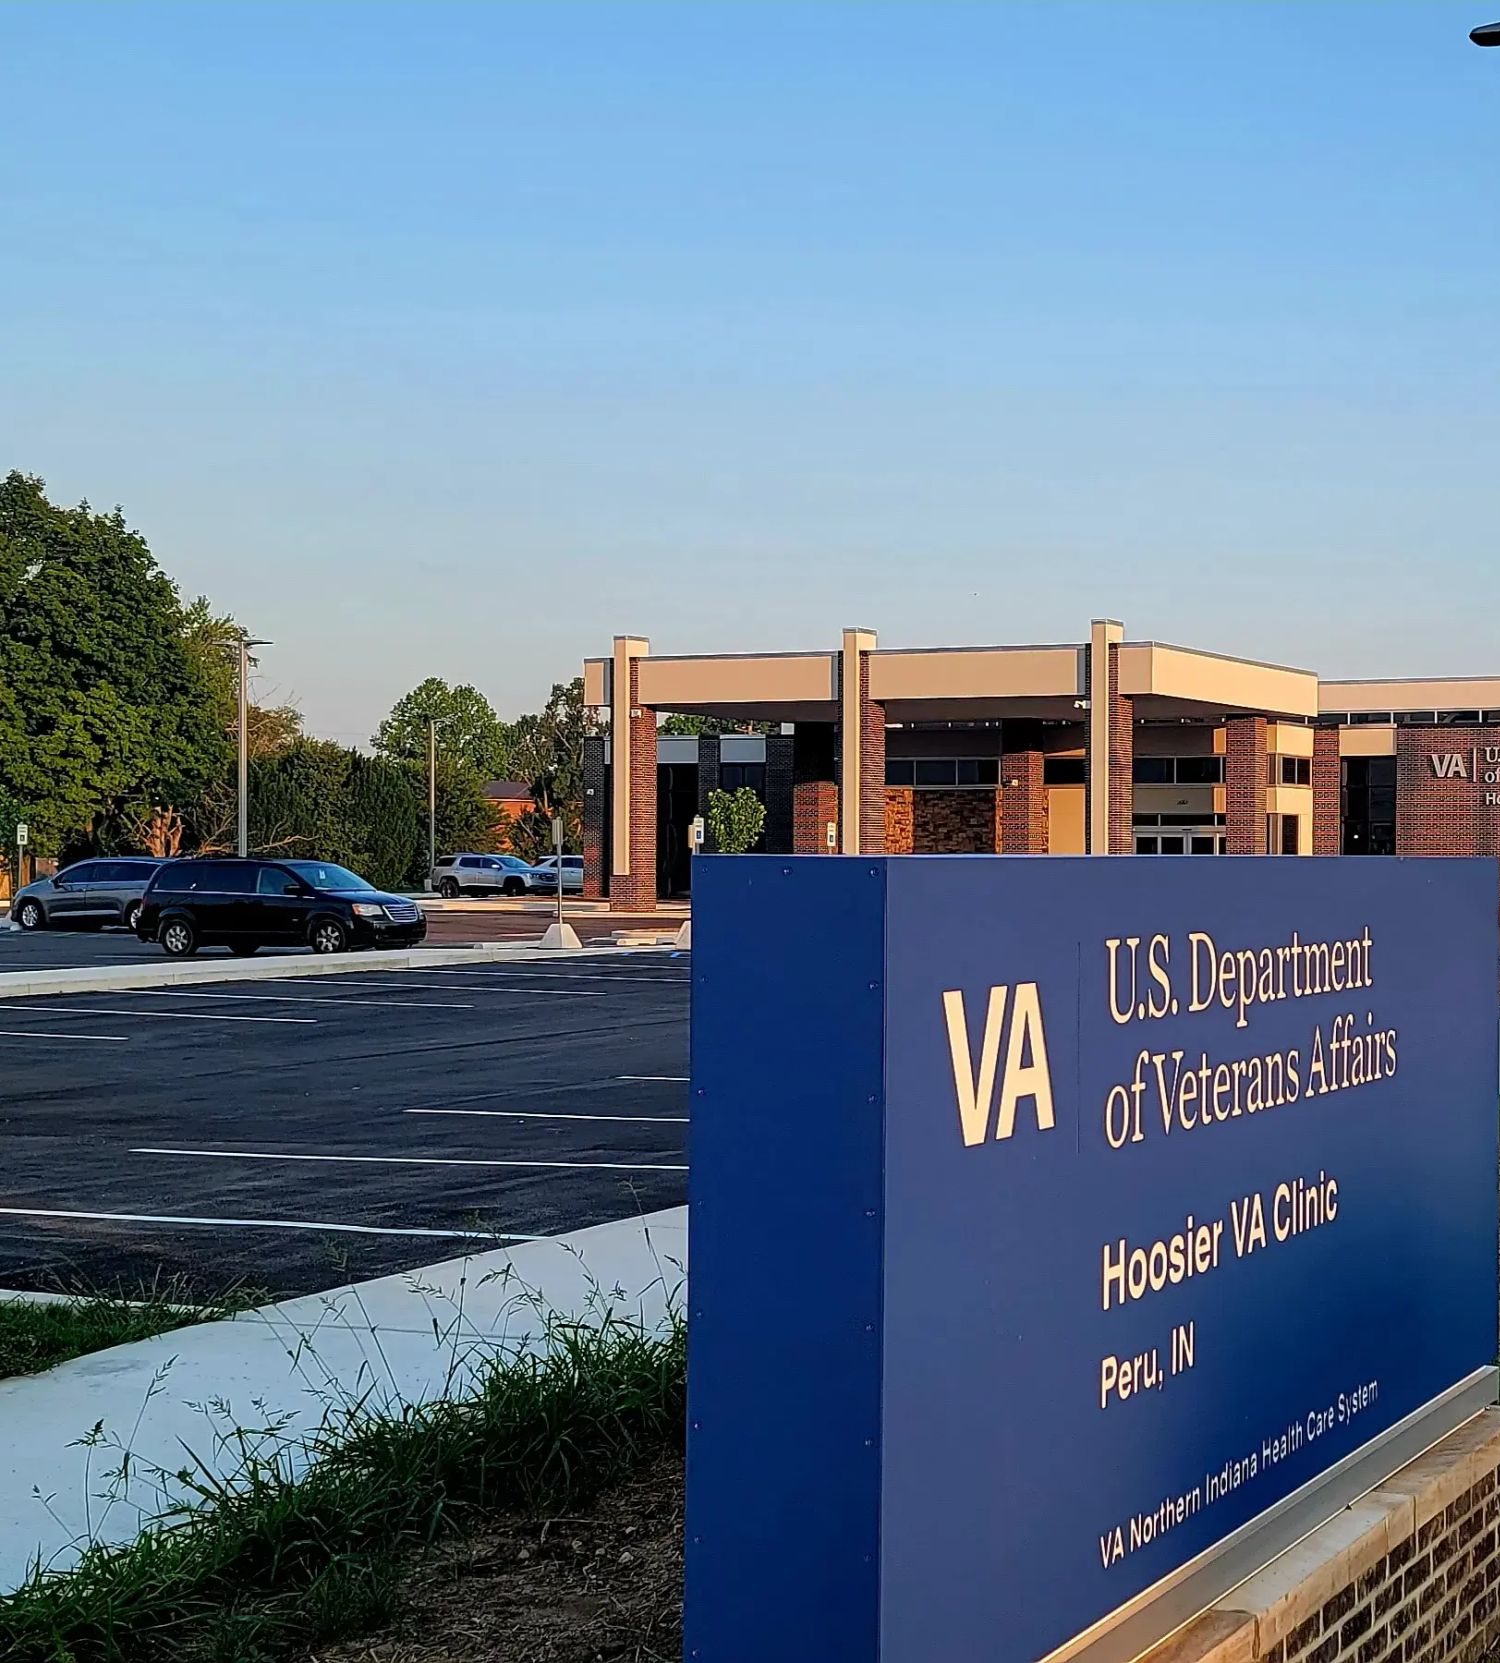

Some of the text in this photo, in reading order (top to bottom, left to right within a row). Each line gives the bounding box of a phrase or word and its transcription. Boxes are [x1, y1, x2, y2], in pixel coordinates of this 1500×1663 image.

[1431, 754, 1467, 778] VA
[1105, 926, 1373, 1027] U.S. Department
[942, 982, 1055, 1147] VA
[1105, 1012, 1397, 1149] of Veterans Affairs
[1102, 1170, 1338, 1311] Hoosier VA Clinic
[1101, 1321, 1195, 1409] Peru, IN
[1099, 1379, 1378, 1569] VA Northern Indiana Health Care System
